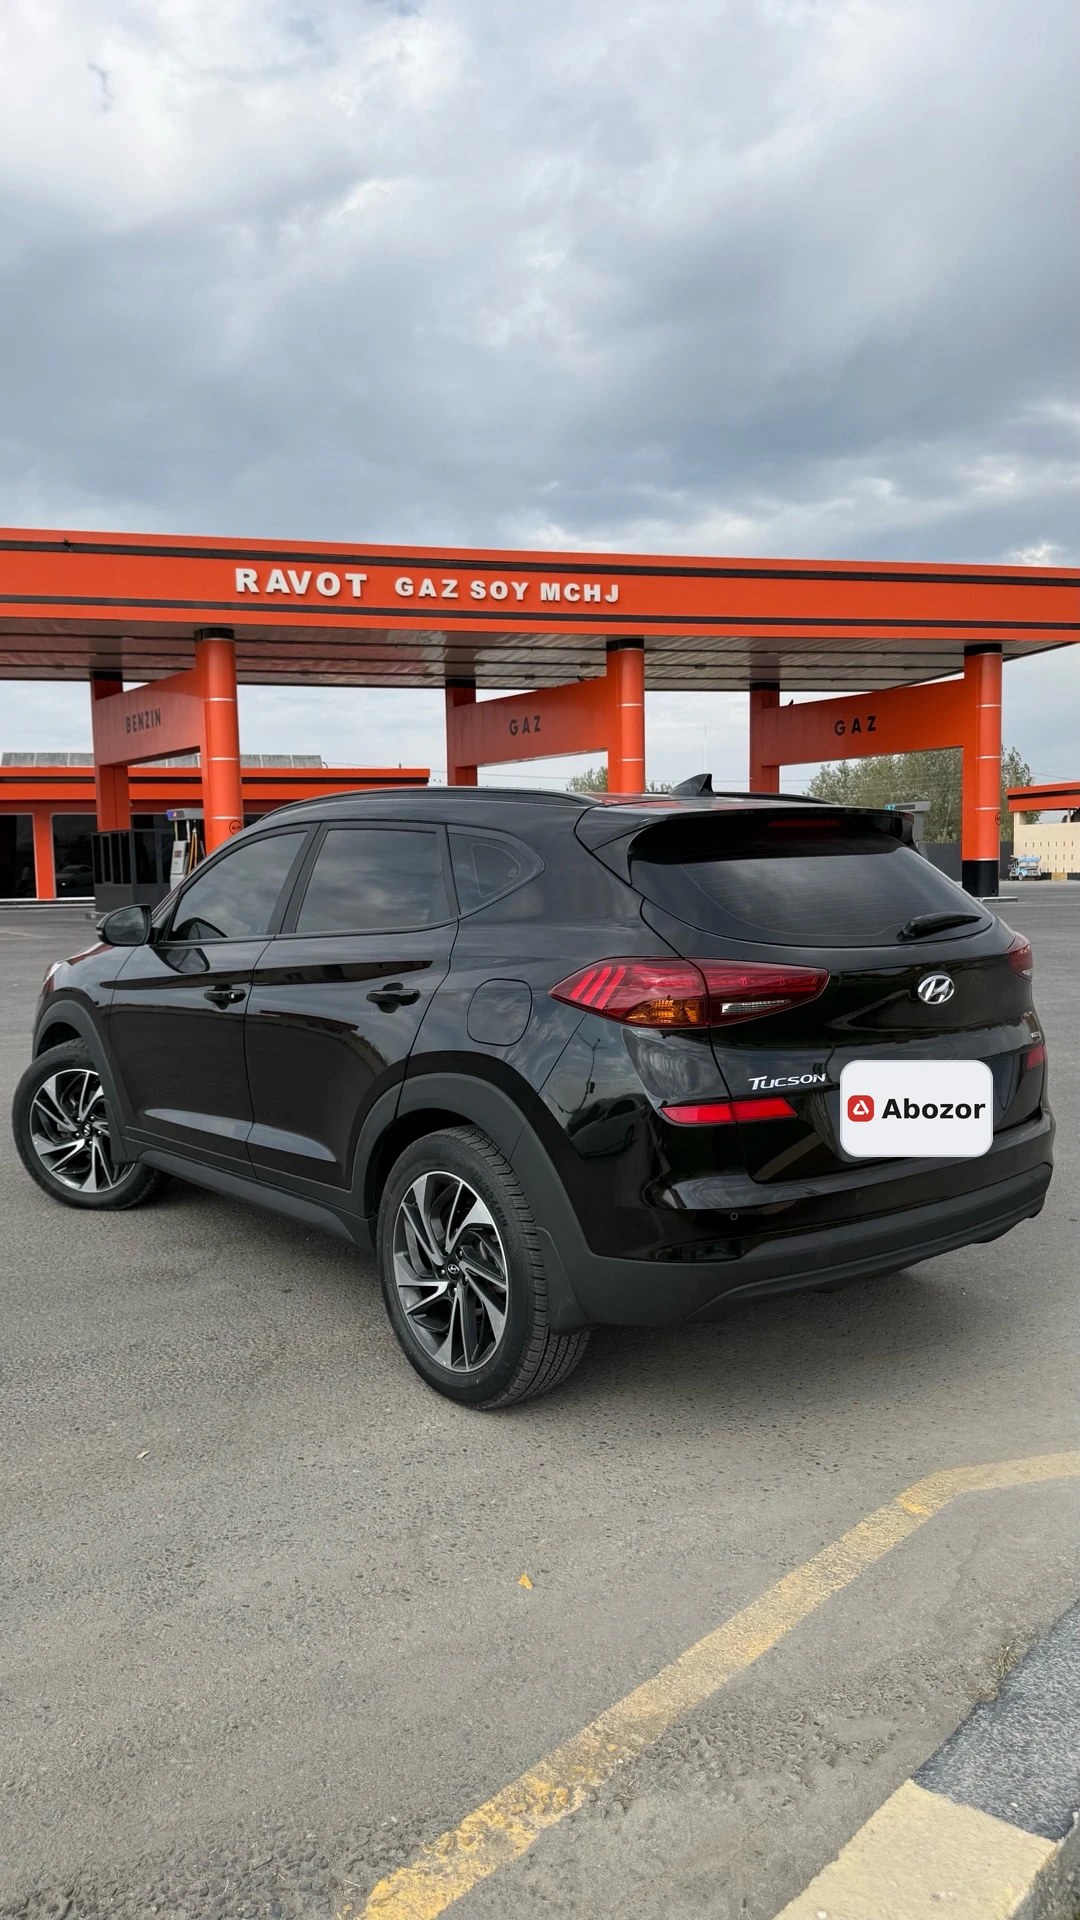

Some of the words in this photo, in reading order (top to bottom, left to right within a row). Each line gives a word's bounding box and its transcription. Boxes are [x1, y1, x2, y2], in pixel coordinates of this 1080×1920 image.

[234, 567, 367, 598] RAVOT
[394, 576, 459, 599] GAZ
[469, 580, 530, 601] SOY
[540, 582, 620, 603] MCHJ
[125, 707, 162, 734] BENZIN
[509, 714, 541, 737] GAZ
[833, 714, 877, 737] GAZ
